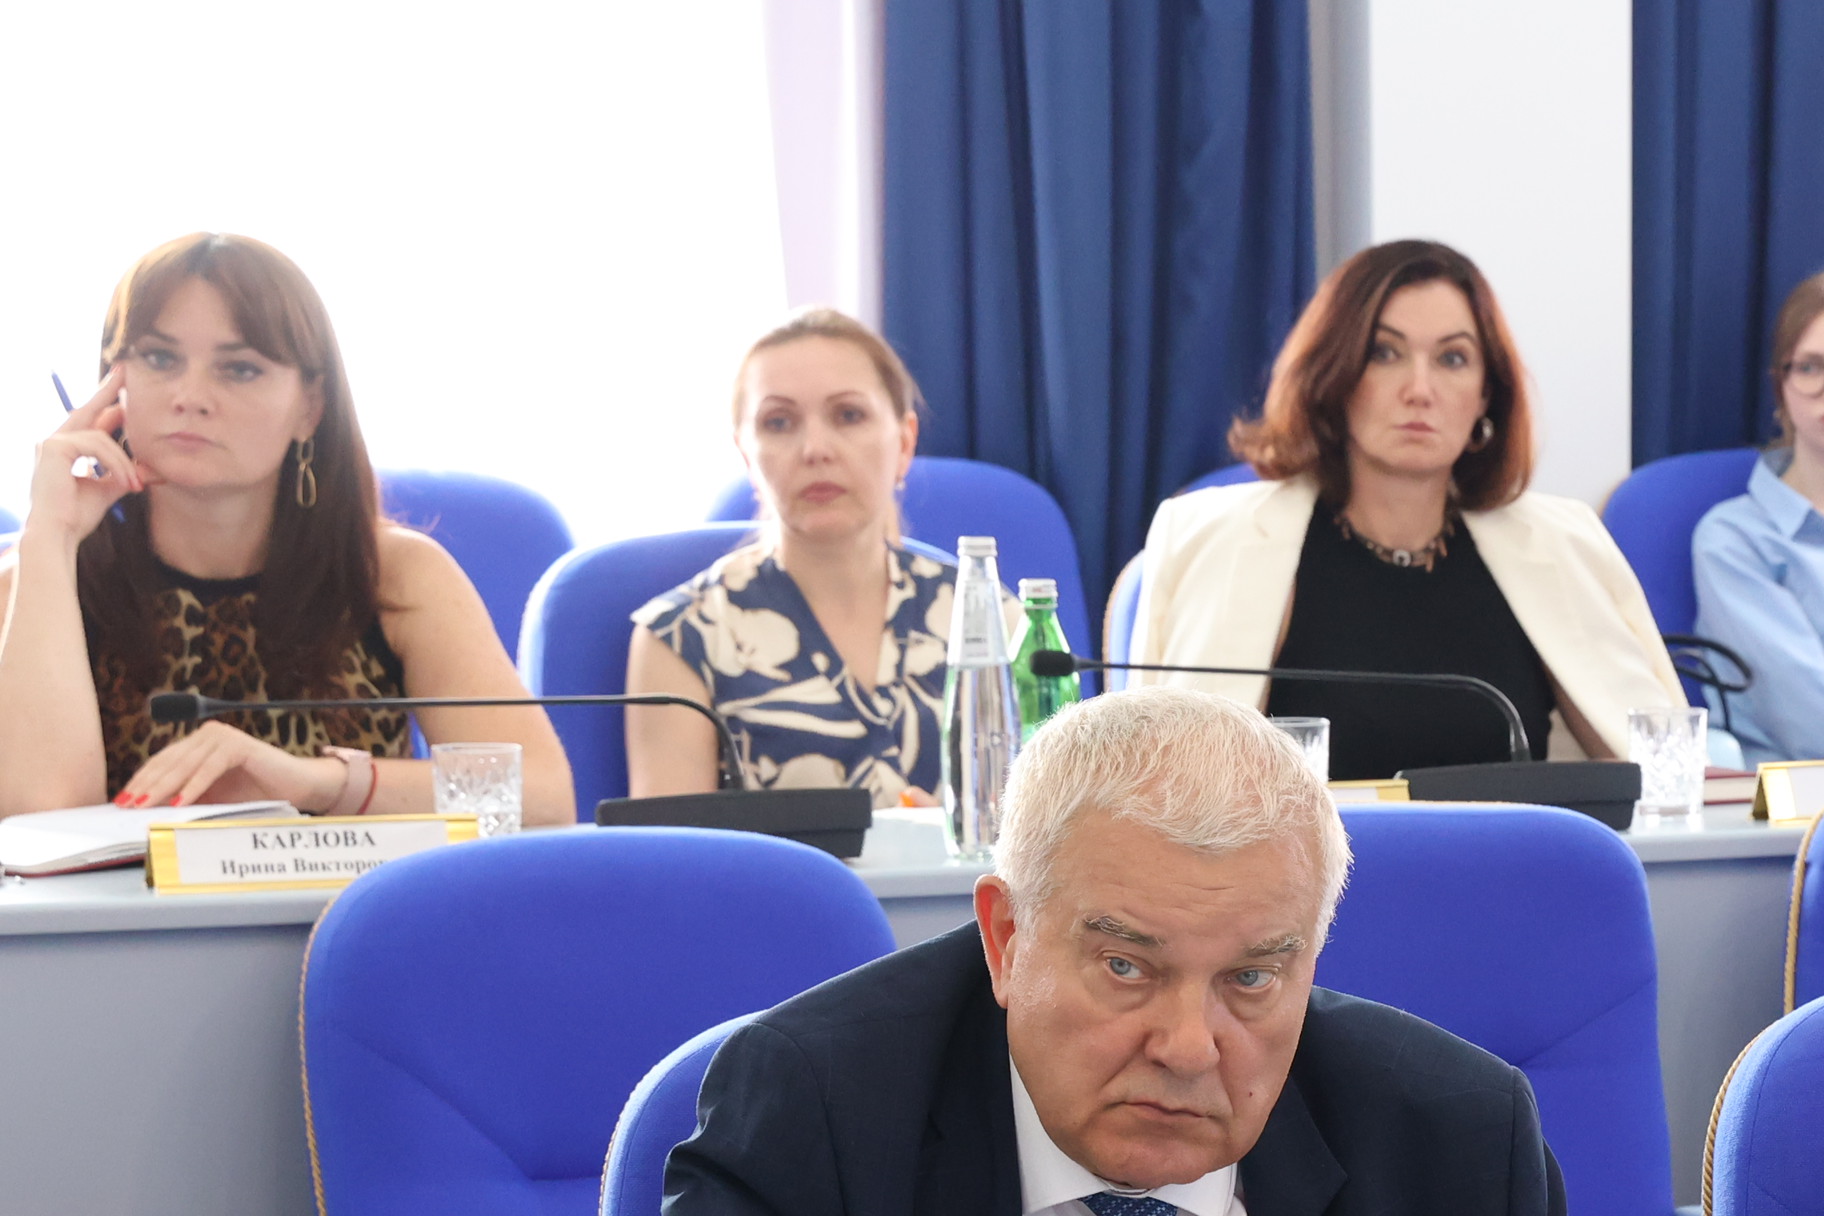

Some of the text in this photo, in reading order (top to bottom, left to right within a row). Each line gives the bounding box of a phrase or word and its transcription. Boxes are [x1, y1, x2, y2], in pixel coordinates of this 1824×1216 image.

[251, 830, 377, 850] КАРЛОВА
[220, 857, 387, 878] Ирина Викторо
